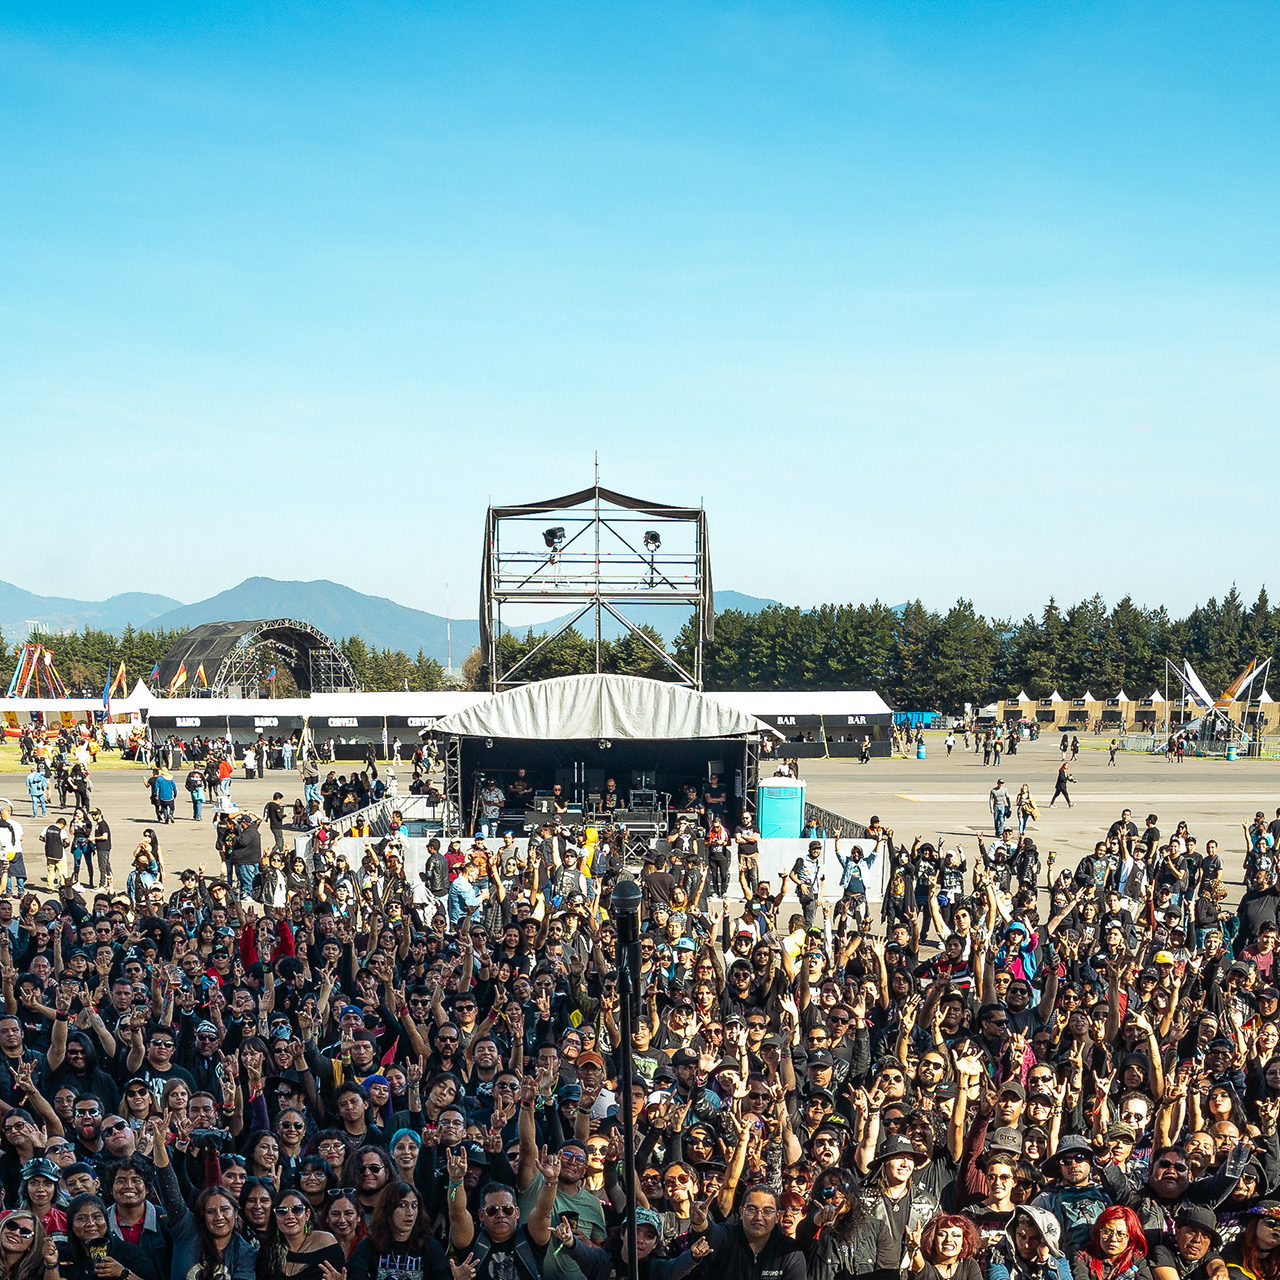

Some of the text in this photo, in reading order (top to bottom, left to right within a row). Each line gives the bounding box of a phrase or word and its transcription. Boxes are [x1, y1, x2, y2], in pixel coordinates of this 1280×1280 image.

[777, 716, 796, 725] BAR
[848, 716, 867, 724] BAR
[999, 1133, 1017, 1143] SICK
